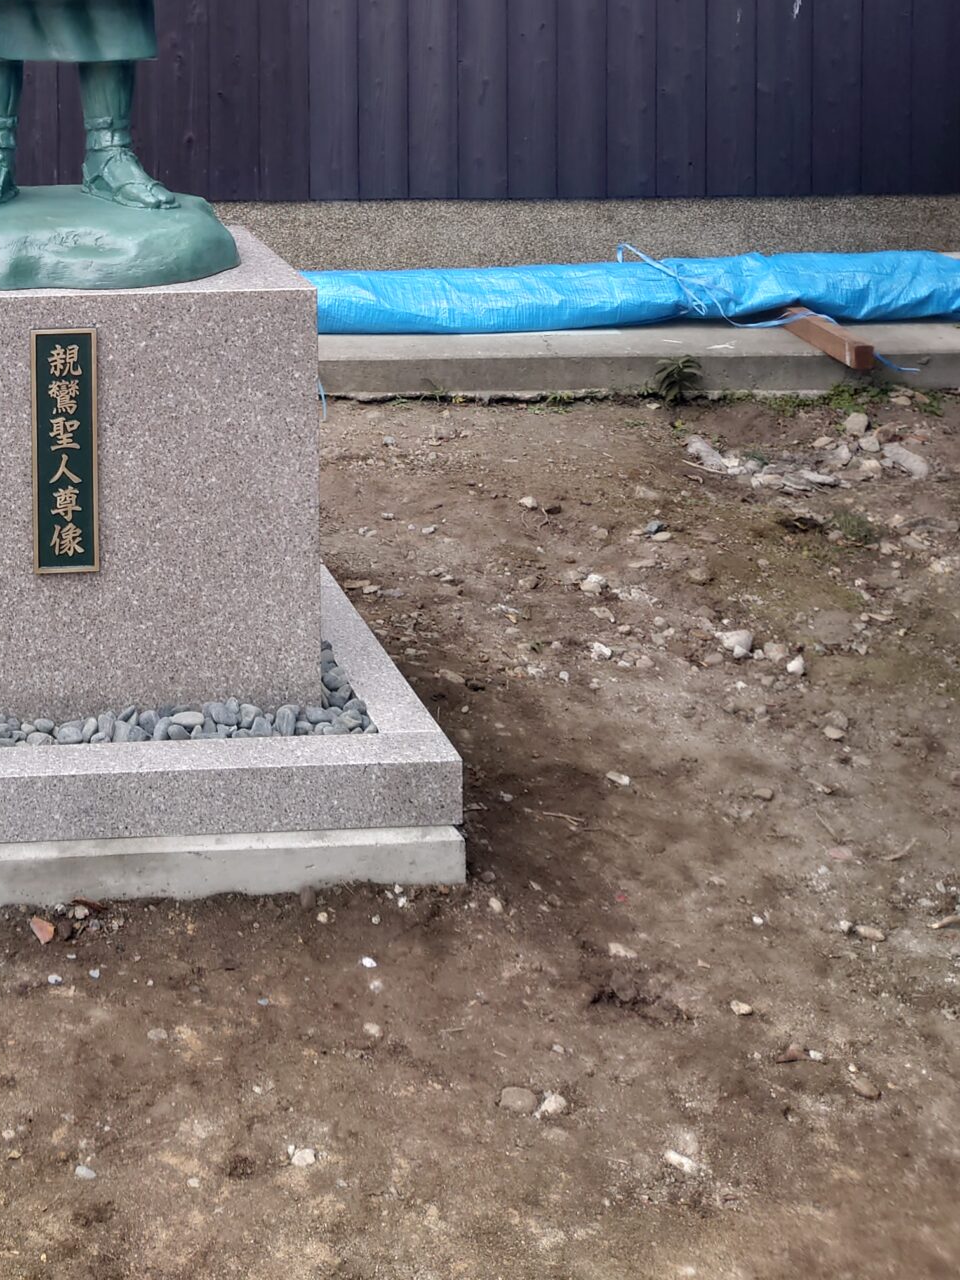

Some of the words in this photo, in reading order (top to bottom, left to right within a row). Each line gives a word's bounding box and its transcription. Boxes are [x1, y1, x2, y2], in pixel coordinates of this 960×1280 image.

[47, 343, 85, 557] 親鸞聖人尊像
